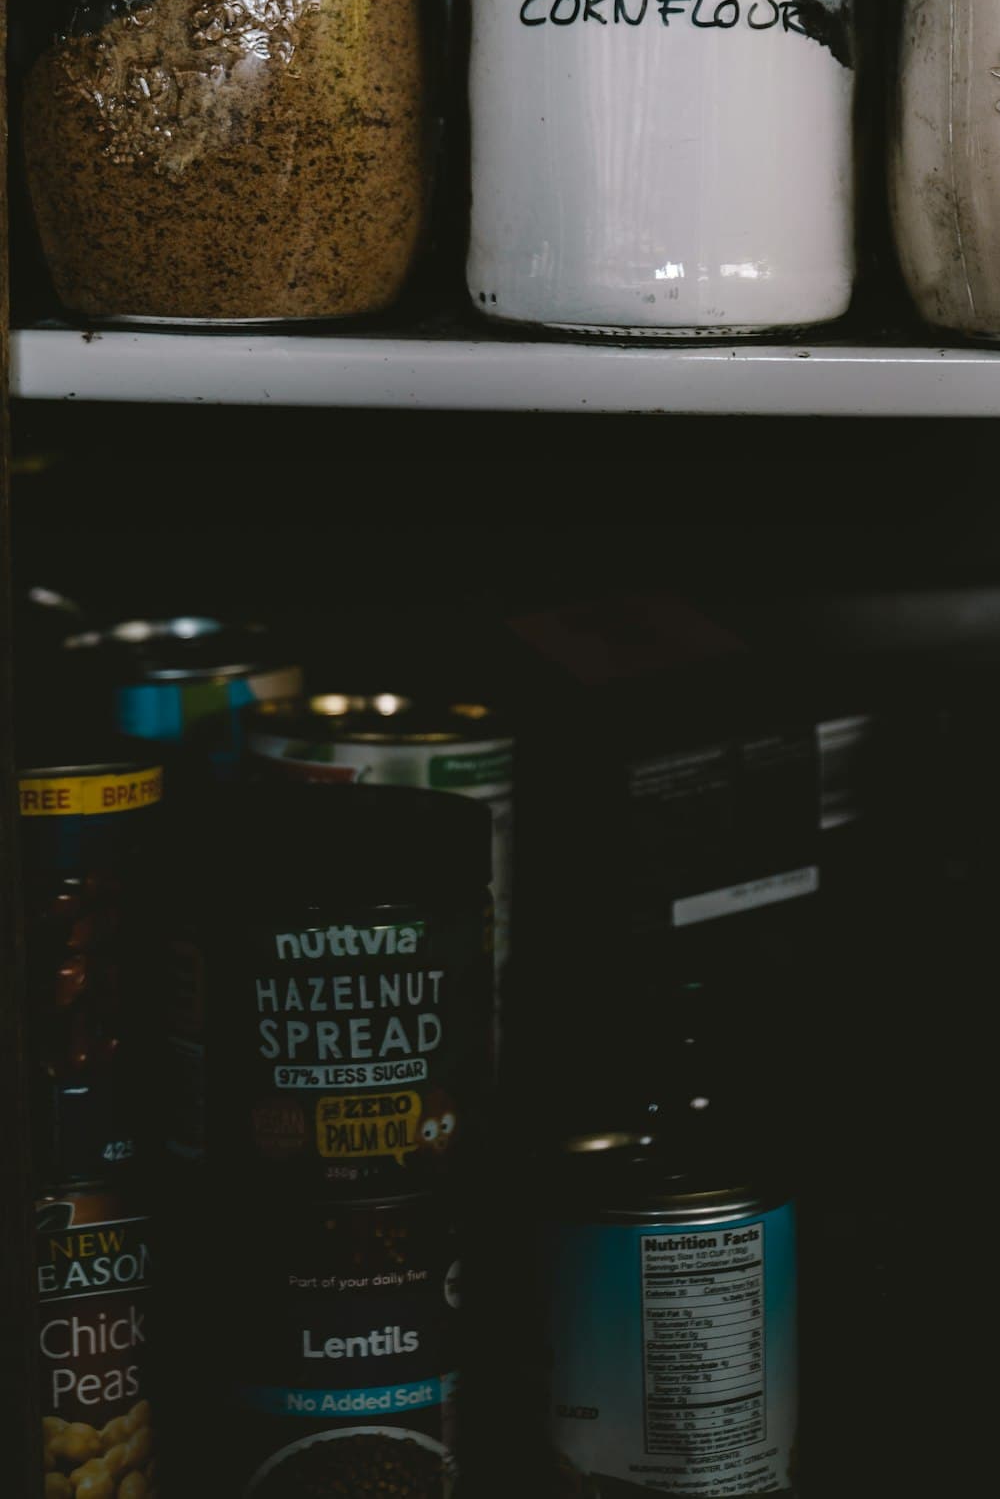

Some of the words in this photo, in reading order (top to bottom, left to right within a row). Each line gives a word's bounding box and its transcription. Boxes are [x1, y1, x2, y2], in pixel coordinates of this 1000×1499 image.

[21, 788, 72, 811] REE
[102, 784, 138, 806] BPA
[275, 925, 413, 959] nuttvia
[255, 969, 445, 1013] HAZELNUT
[258, 1012, 442, 1061] SPREAD
[277, 1069, 320, 1086] 97%
[324, 1066, 367, 1085] LESS
[373, 1060, 424, 1083] SUGAR
[343, 1095, 412, 1120] ZERO
[326, 1120, 378, 1153] PALM
[384, 1118, 416, 1149] OIL
[50, 1228, 128, 1263] NEW
[644, 1236, 718, 1252] Nutrition
[723, 1229, 760, 1246] Facts
[288, 1275, 318, 1289] Part
[320, 1276, 337, 1289] of
[339, 1276, 370, 1292] your
[371, 1272, 404, 1289] daily
[39, 1304, 145, 1361] Chick
[302, 1326, 419, 1359] Lentils
[52, 1364, 140, 1409] Peas
[286, 1391, 317, 1412] No
[320, 1390, 392, 1412] Added
[394, 1384, 433, 1407] Salt
